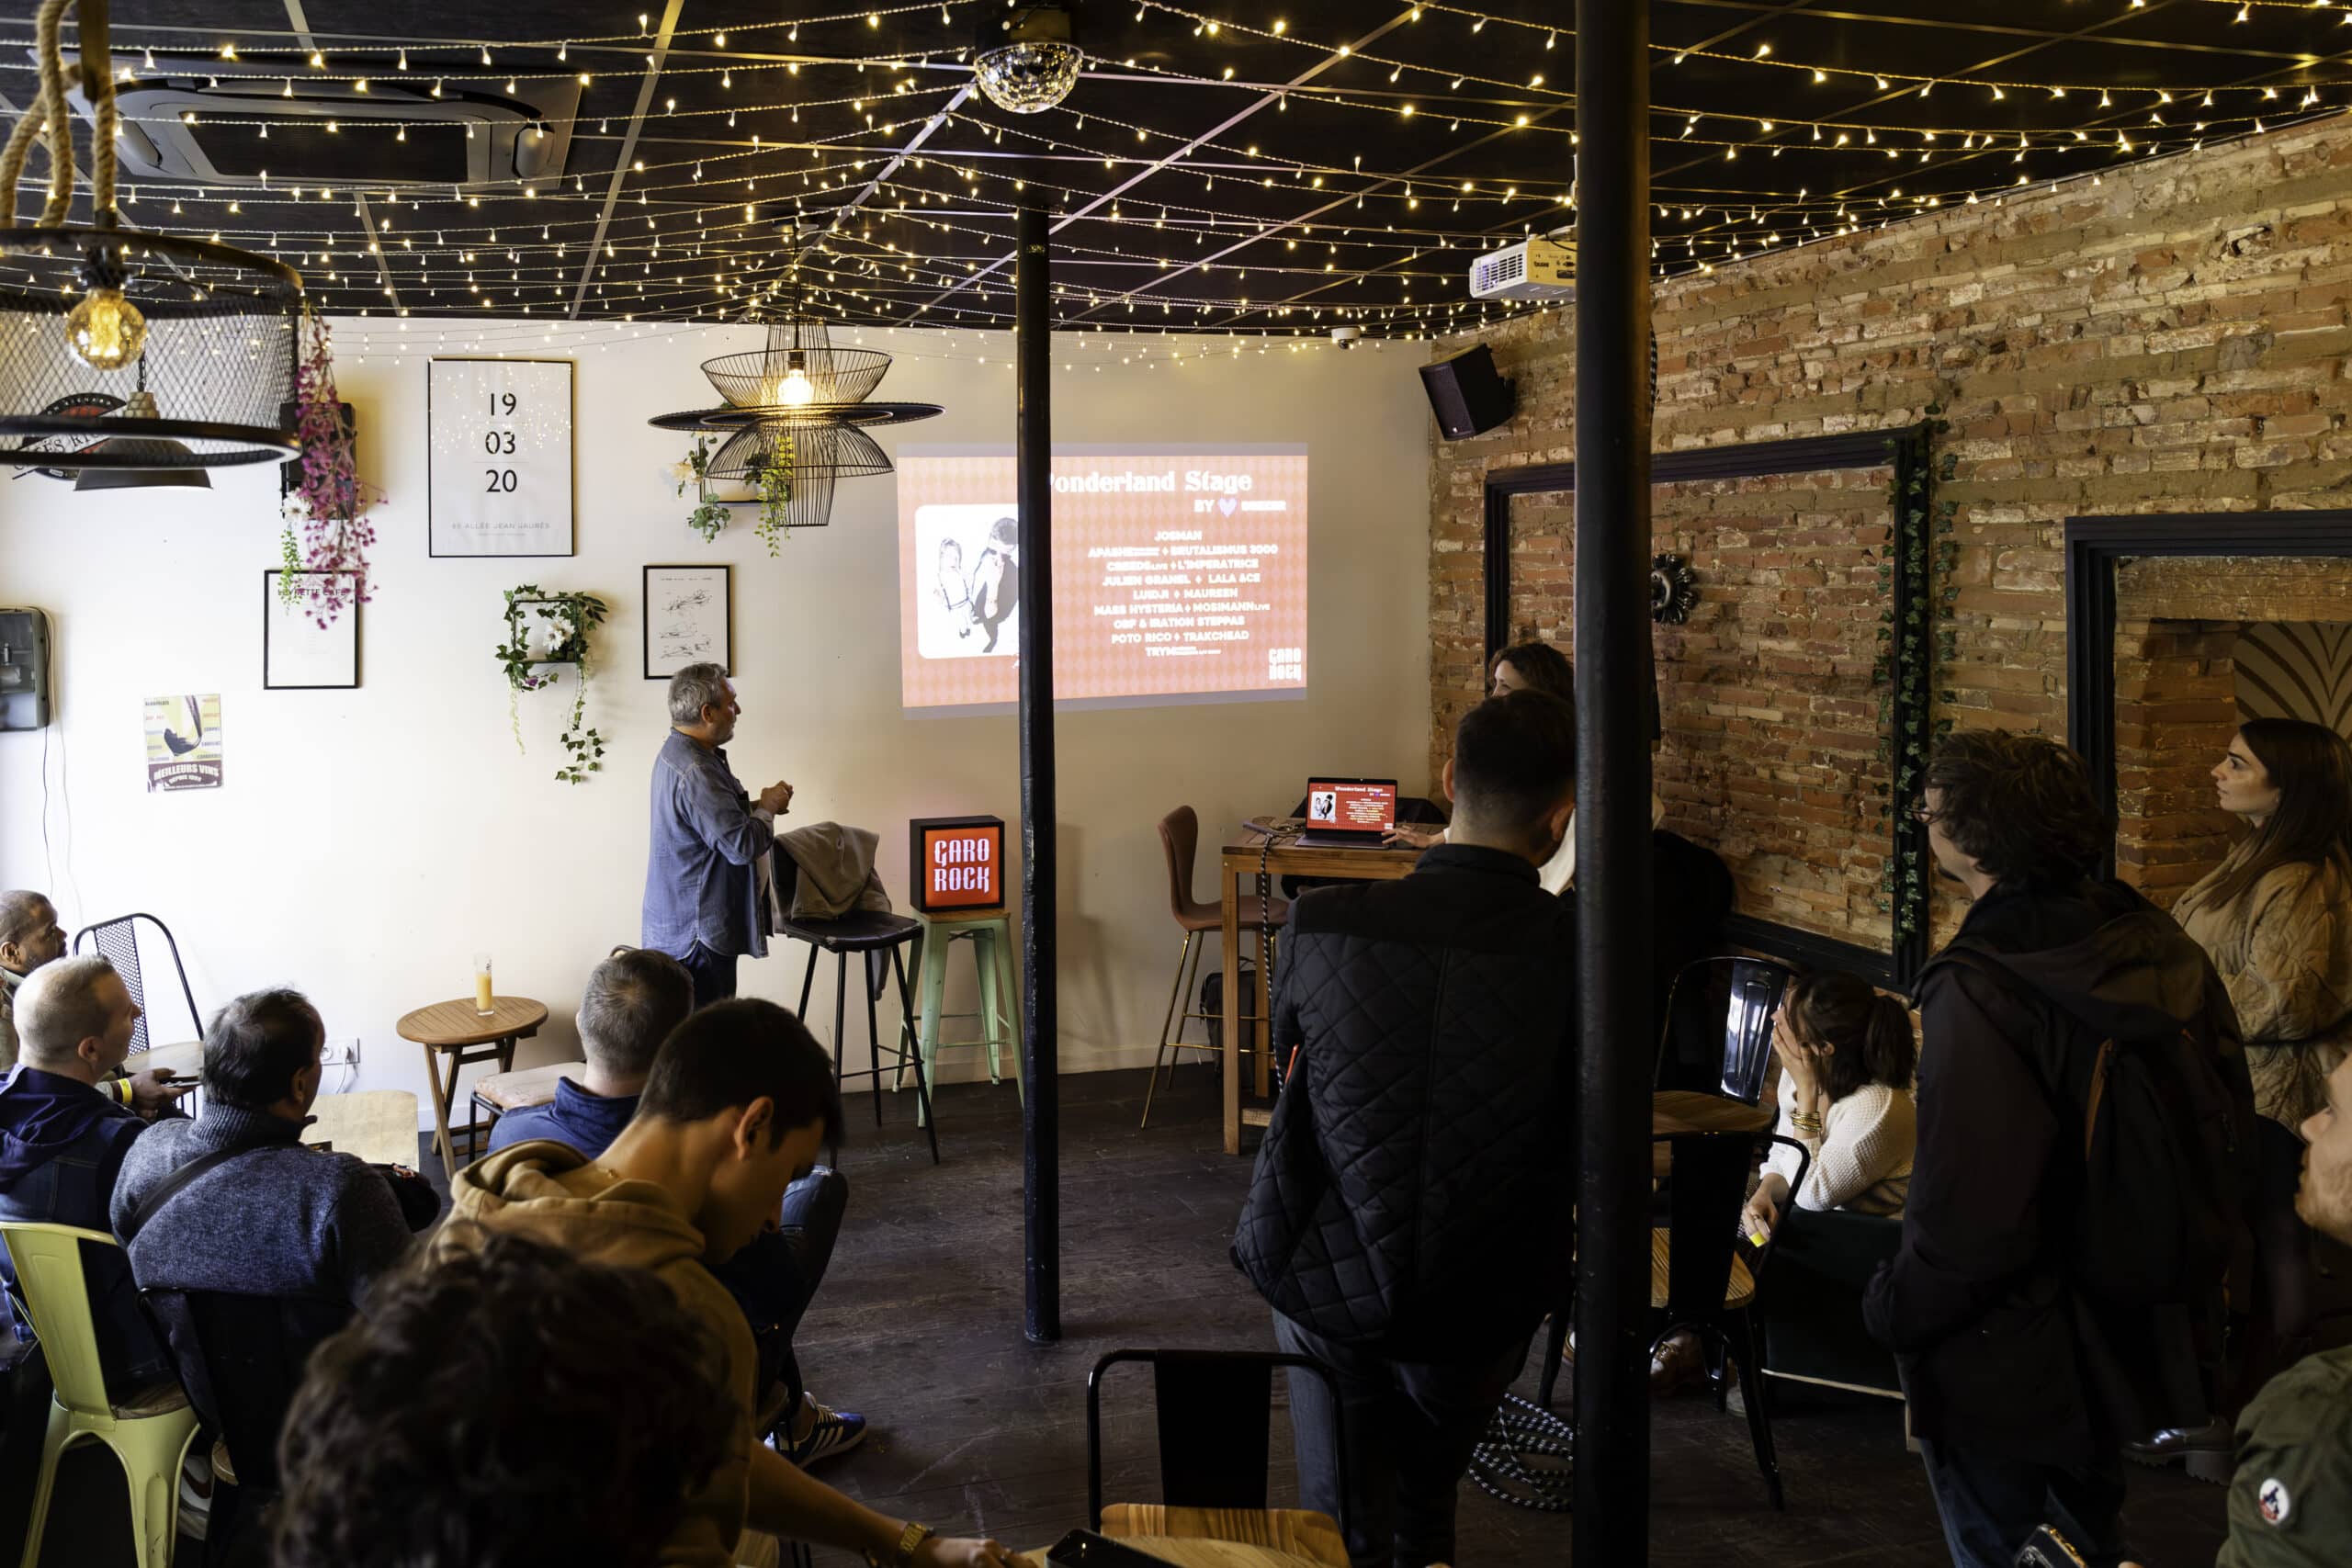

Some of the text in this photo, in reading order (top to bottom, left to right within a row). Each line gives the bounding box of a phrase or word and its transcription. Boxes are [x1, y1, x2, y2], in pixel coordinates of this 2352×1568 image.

[490, 392, 517, 416] 19
[485, 431, 516, 455] 03
[485, 468, 517, 492] 20
[1050, 470, 1253, 495] onderland Stage
[1193, 499, 1216, 513] BY
[1111, 633, 1142, 644] POTO
[1145, 632, 1172, 643] RICO
[933, 838, 991, 868] GARO
[933, 866, 991, 895] ROCK
